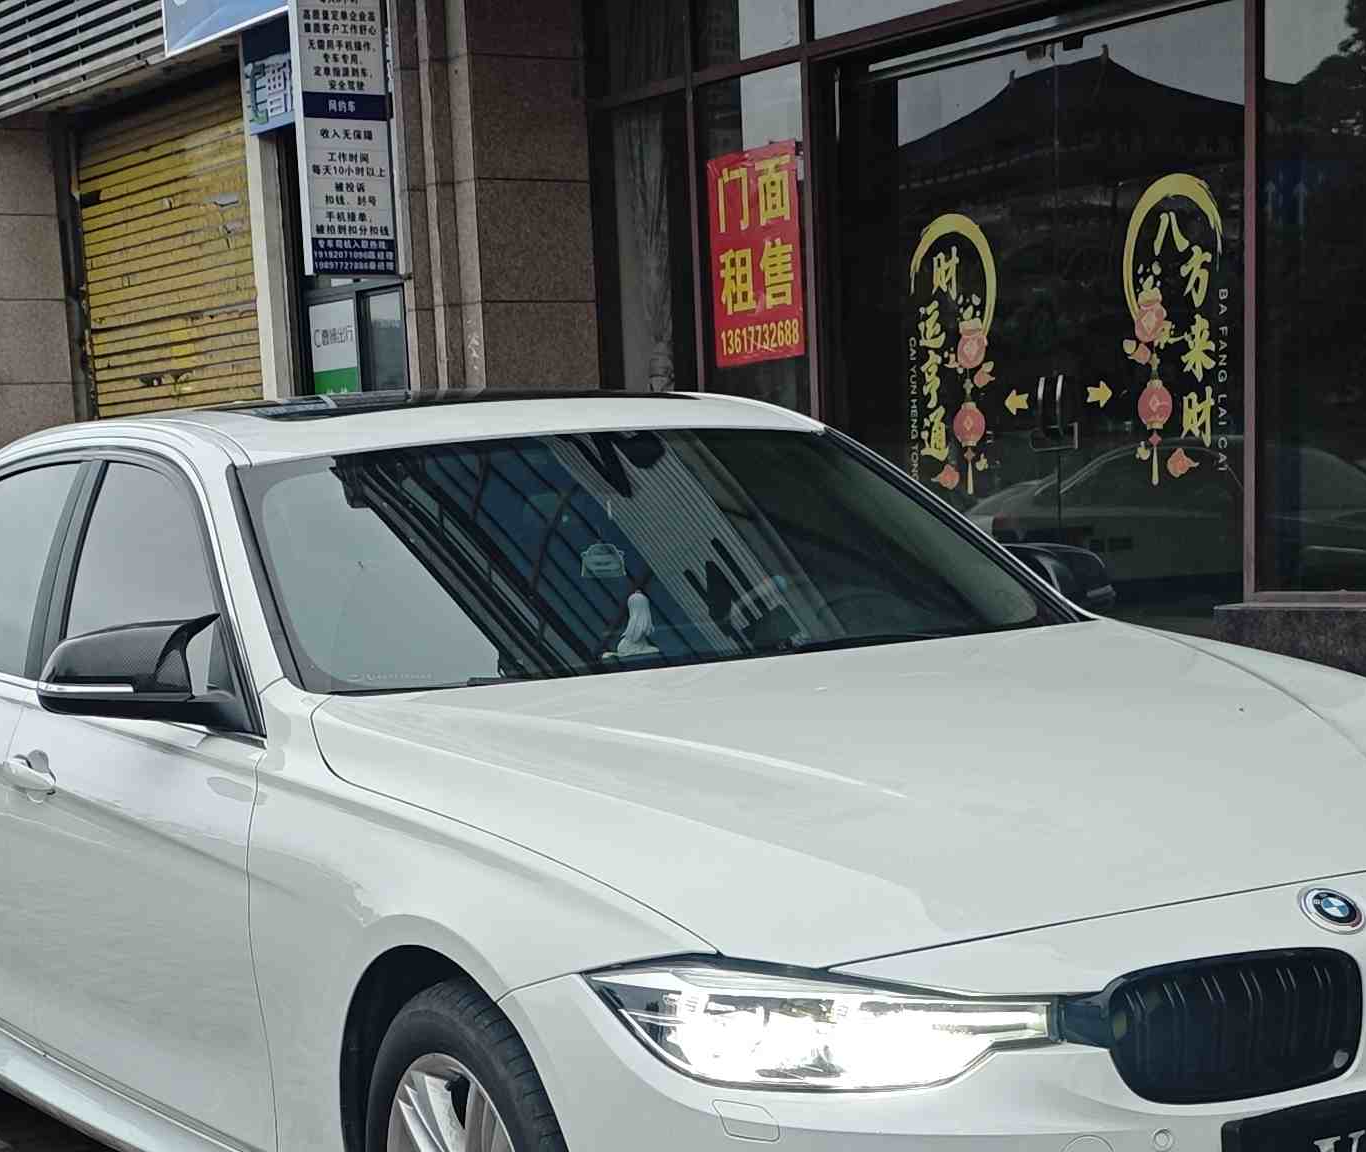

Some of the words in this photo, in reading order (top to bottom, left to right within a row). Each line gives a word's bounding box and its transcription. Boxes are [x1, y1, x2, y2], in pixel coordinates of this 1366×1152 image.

[320, 128, 373, 140] 收入无保障
[312, 164, 385, 177] 每天10小时以上
[328, 151, 369, 163] 工作时间
[718, 154, 791, 233] 门面
[719, 238, 795, 316] 租售
[1218, 288, 1228, 315] BA
[721, 318, 800, 356] 13617732688
[1154, 211, 1216, 448] 八方来财
[909, 337, 917, 361] CAI
[919, 246, 960, 461] 财运亨通
[1218, 326, 1228, 383] FANG
[909, 366, 918, 395] YUN
[910, 401, 919, 440] HENG
[1218, 394, 1228, 425] LAI
[1218, 436, 1228, 471] CAI
